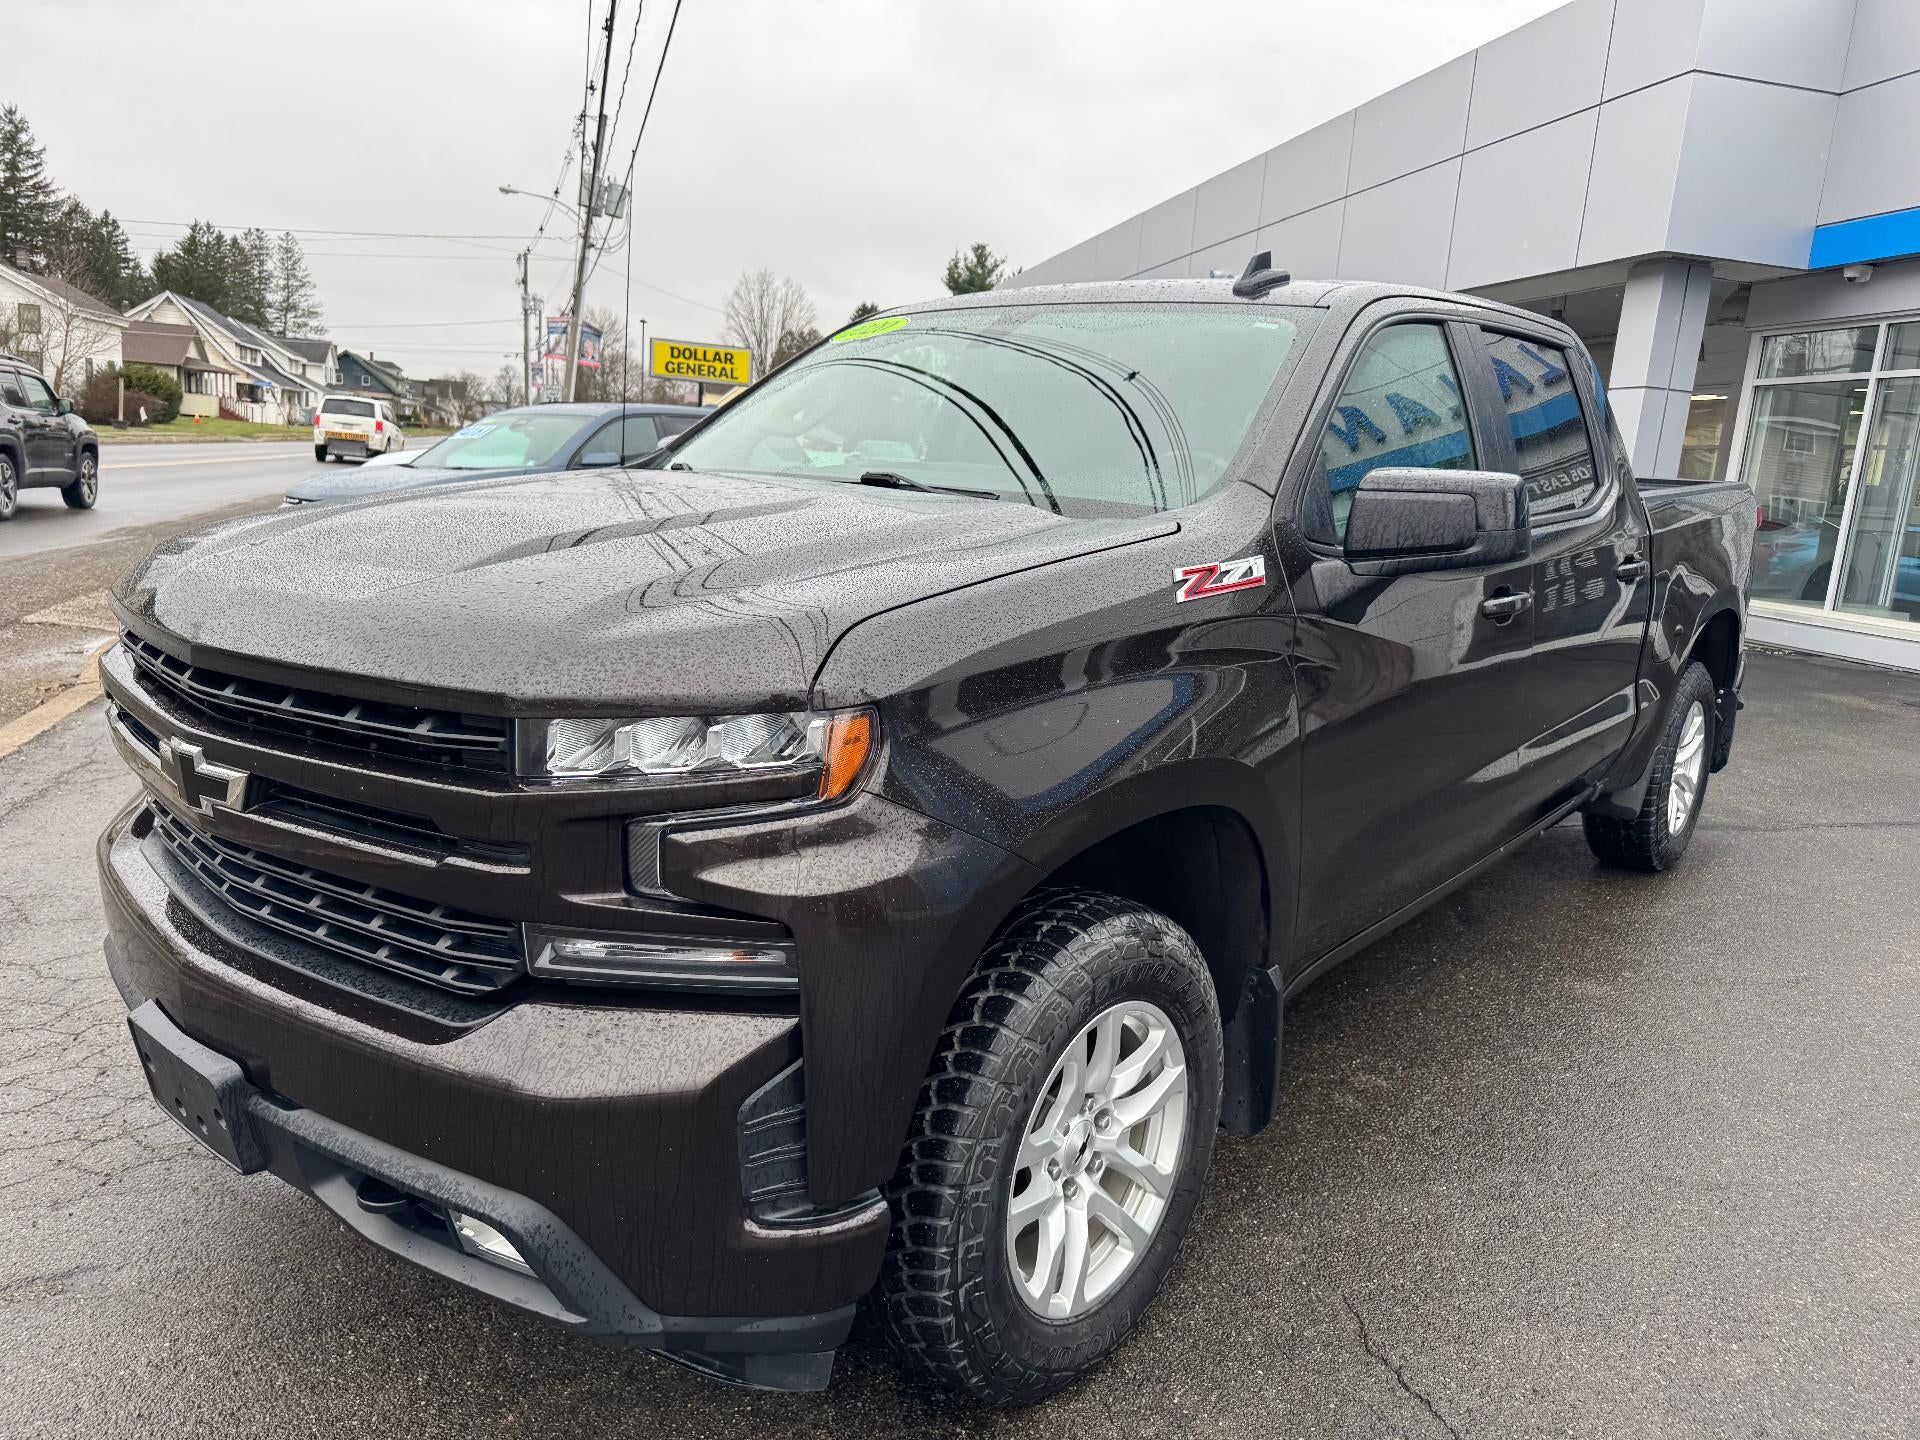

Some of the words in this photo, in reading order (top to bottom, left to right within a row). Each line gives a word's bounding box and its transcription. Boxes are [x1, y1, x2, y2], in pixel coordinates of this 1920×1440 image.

[669, 346, 735, 365] DOLLAR
[665, 361, 739, 379] GENERAL
[1173, 554, 1265, 604] Z71
